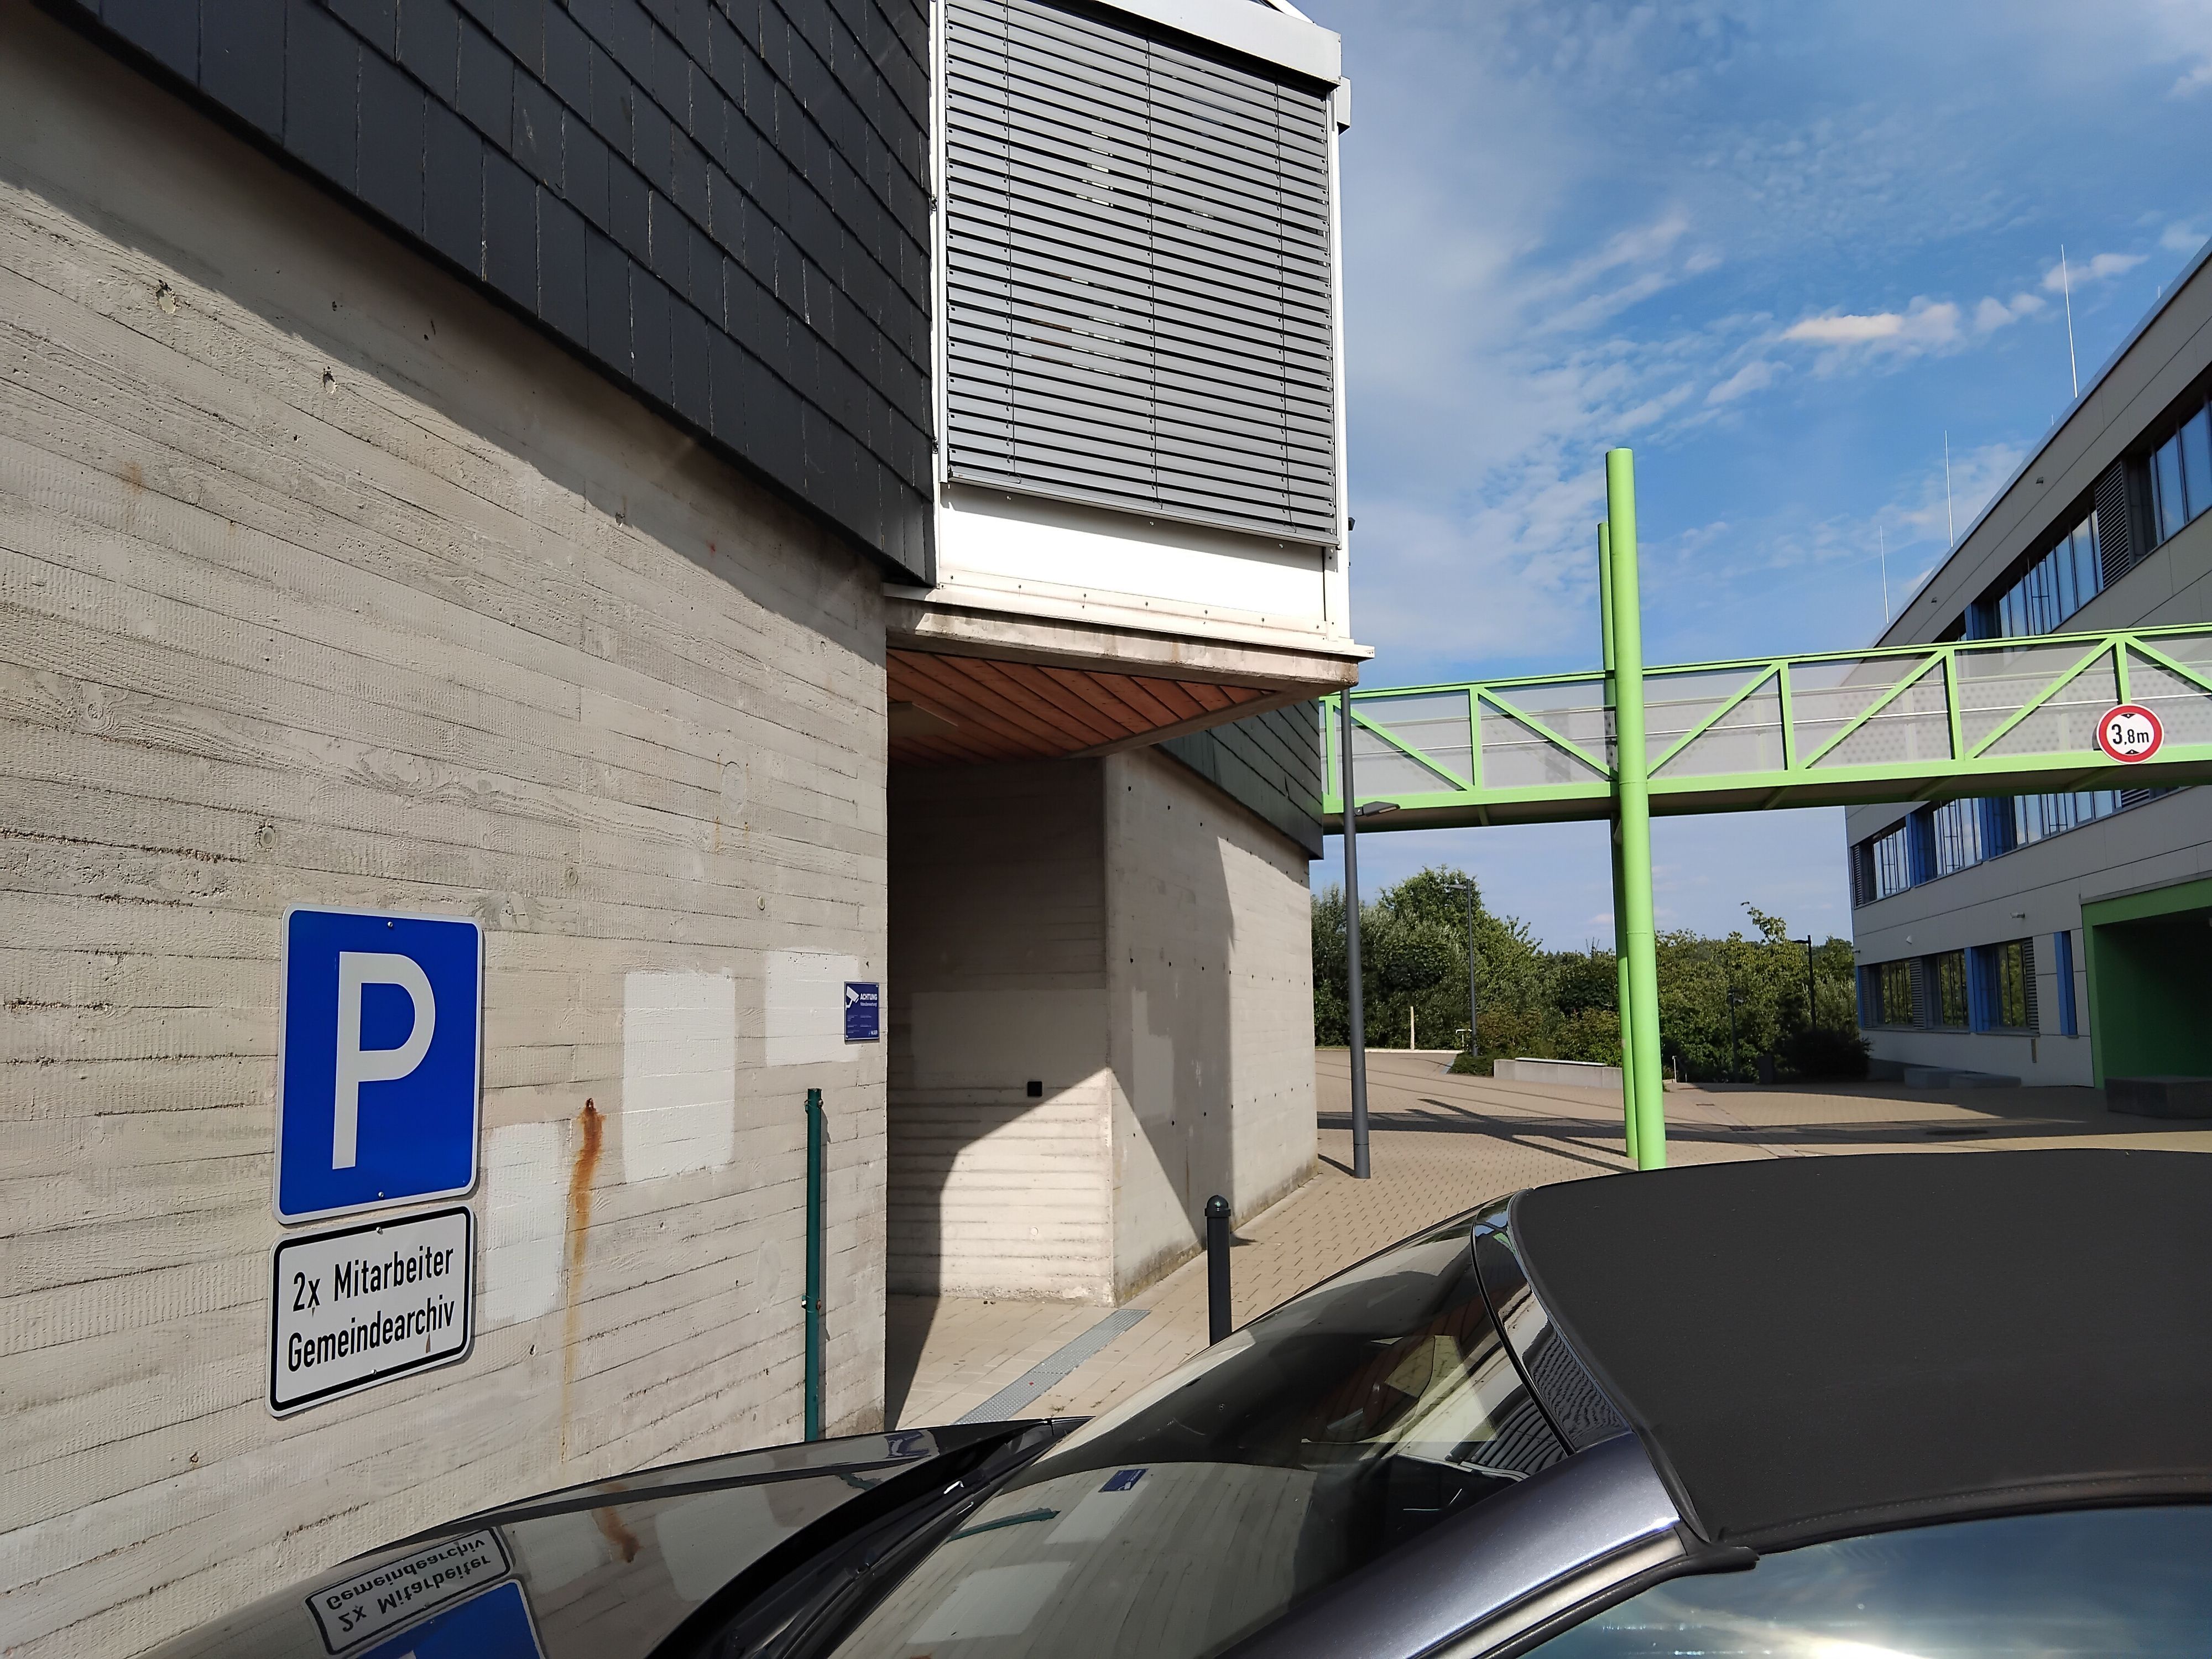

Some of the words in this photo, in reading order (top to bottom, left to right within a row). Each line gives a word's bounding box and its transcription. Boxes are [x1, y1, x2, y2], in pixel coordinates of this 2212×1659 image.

[2111, 724, 2150, 745] 3,8m
[332, 951, 436, 1170] P
[293, 1272, 321, 1312] 2x
[334, 1245, 453, 1301] Mitarbeiter
[288, 1295, 455, 1372] Gemeindearchiv
